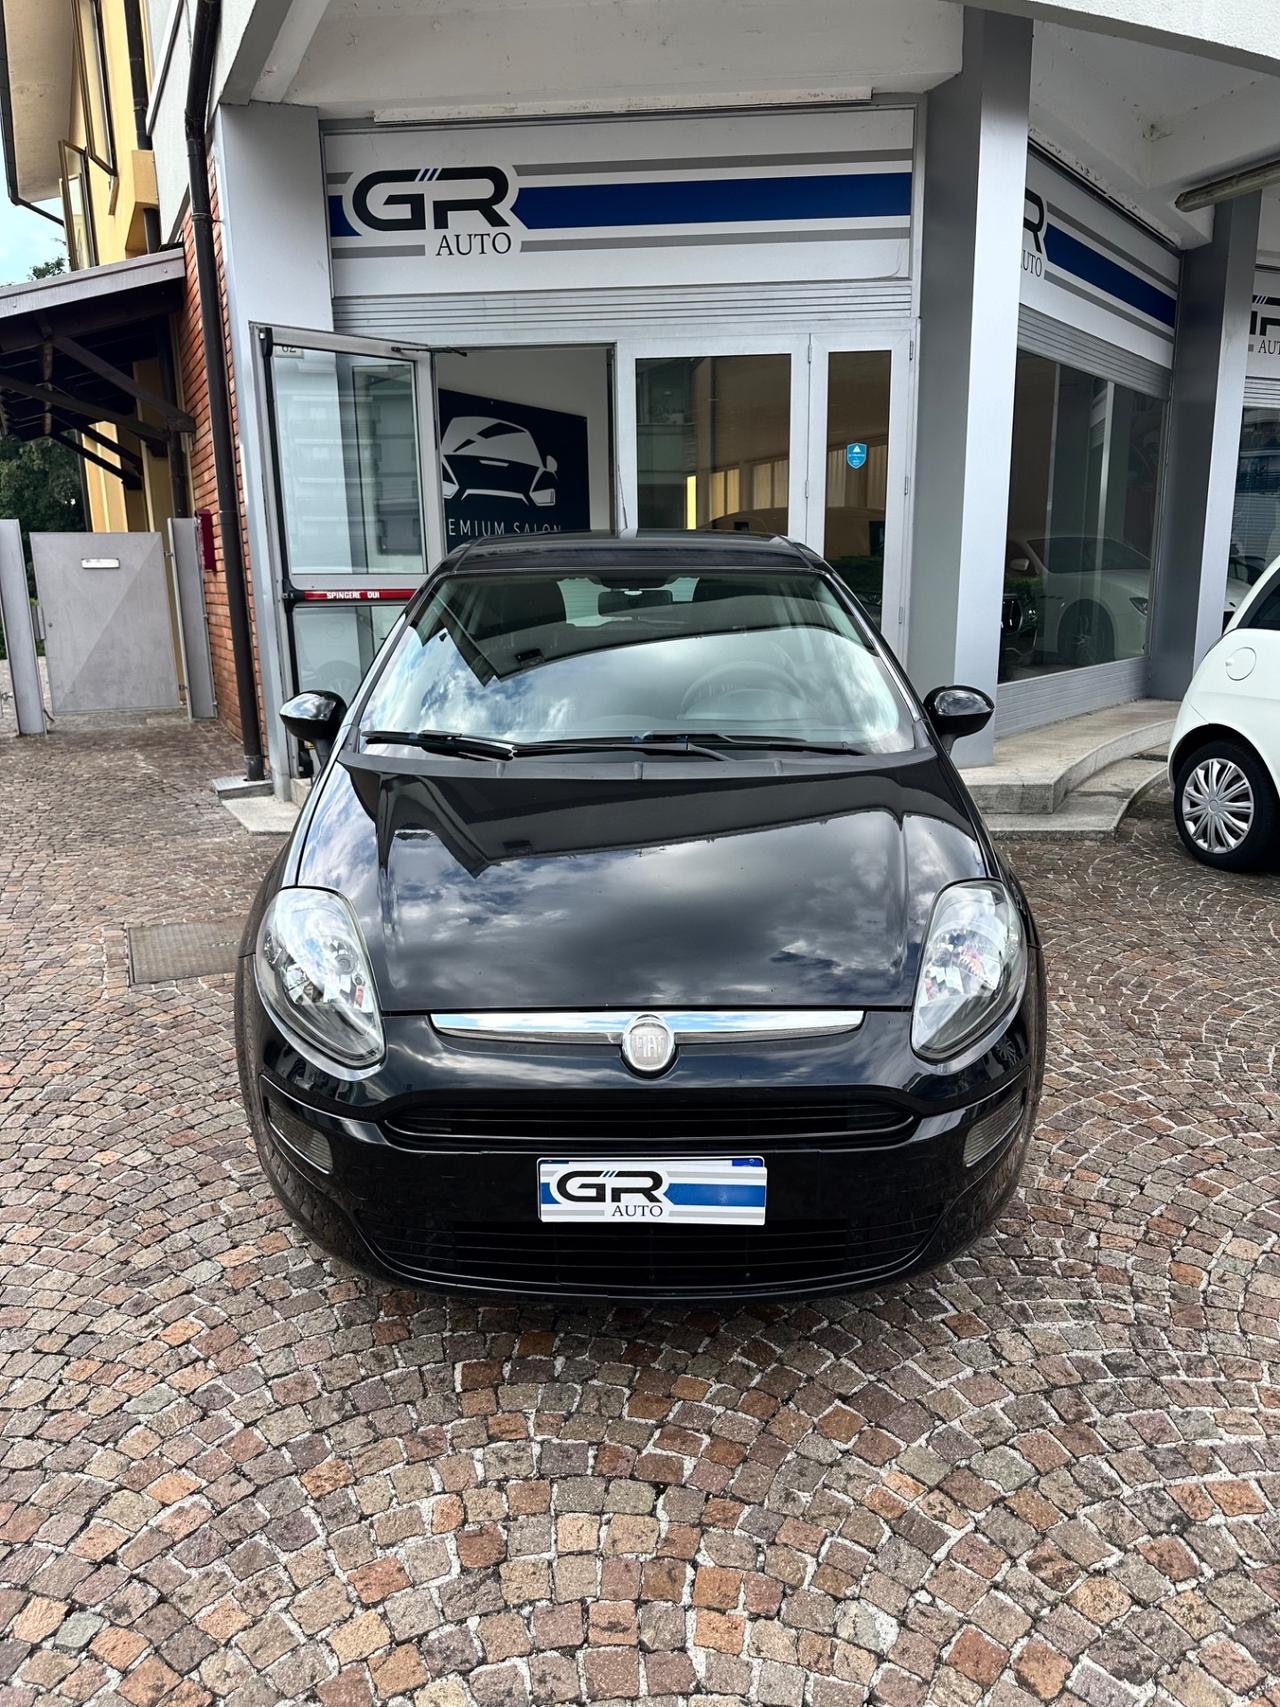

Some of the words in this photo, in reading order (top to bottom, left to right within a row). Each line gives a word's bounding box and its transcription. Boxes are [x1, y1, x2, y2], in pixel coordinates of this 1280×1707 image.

[352, 166, 511, 231] GR
[1022, 187, 1045, 254] R
[435, 232, 512, 256] AUTO
[1021, 248, 1043, 277] UTO
[1258, 339, 1280, 355] AUT
[448, 518, 505, 537] EMIUM
[631, 1034, 666, 1058] FIAT
[556, 1170, 664, 1203] GR
[611, 1205, 664, 1217] AUTO
